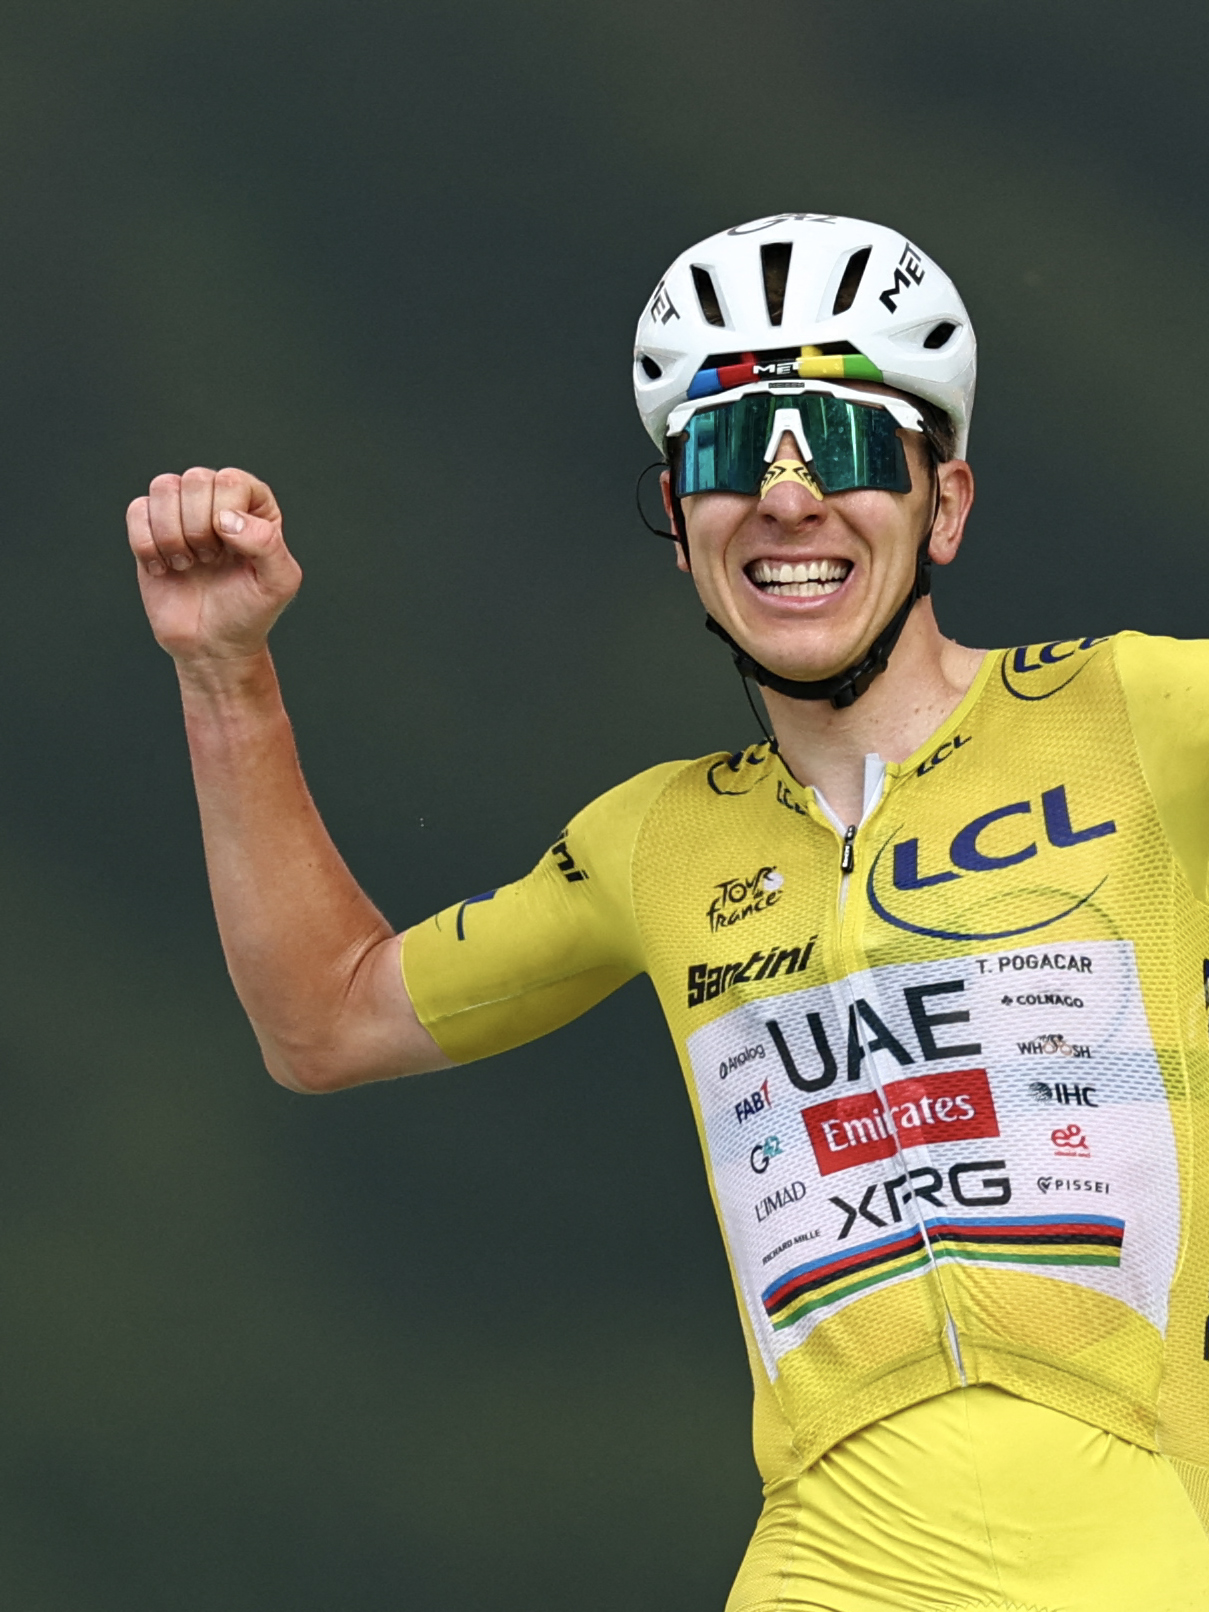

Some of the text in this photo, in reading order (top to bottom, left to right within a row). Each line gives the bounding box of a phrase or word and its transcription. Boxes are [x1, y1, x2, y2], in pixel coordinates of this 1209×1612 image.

[879, 241, 926, 315] MET
[753, 361, 803, 375] MET
[917, 735, 972, 777] LCL
[893, 784, 1116, 890] LCL
[688, 935, 818, 1008] Santini
[976, 953, 1093, 974] T. POGACAR
[1016, 994, 1084, 1008] COLNAGO
[766, 980, 982, 1092] UAE
[728, 1044, 766, 1073] Analog
[1054, 1083, 1099, 1108] IHC
[821, 1094, 976, 1152] Emirates
[828, 1160, 1012, 1240] XRG
[1055, 1180, 1110, 1194] PISSEI
